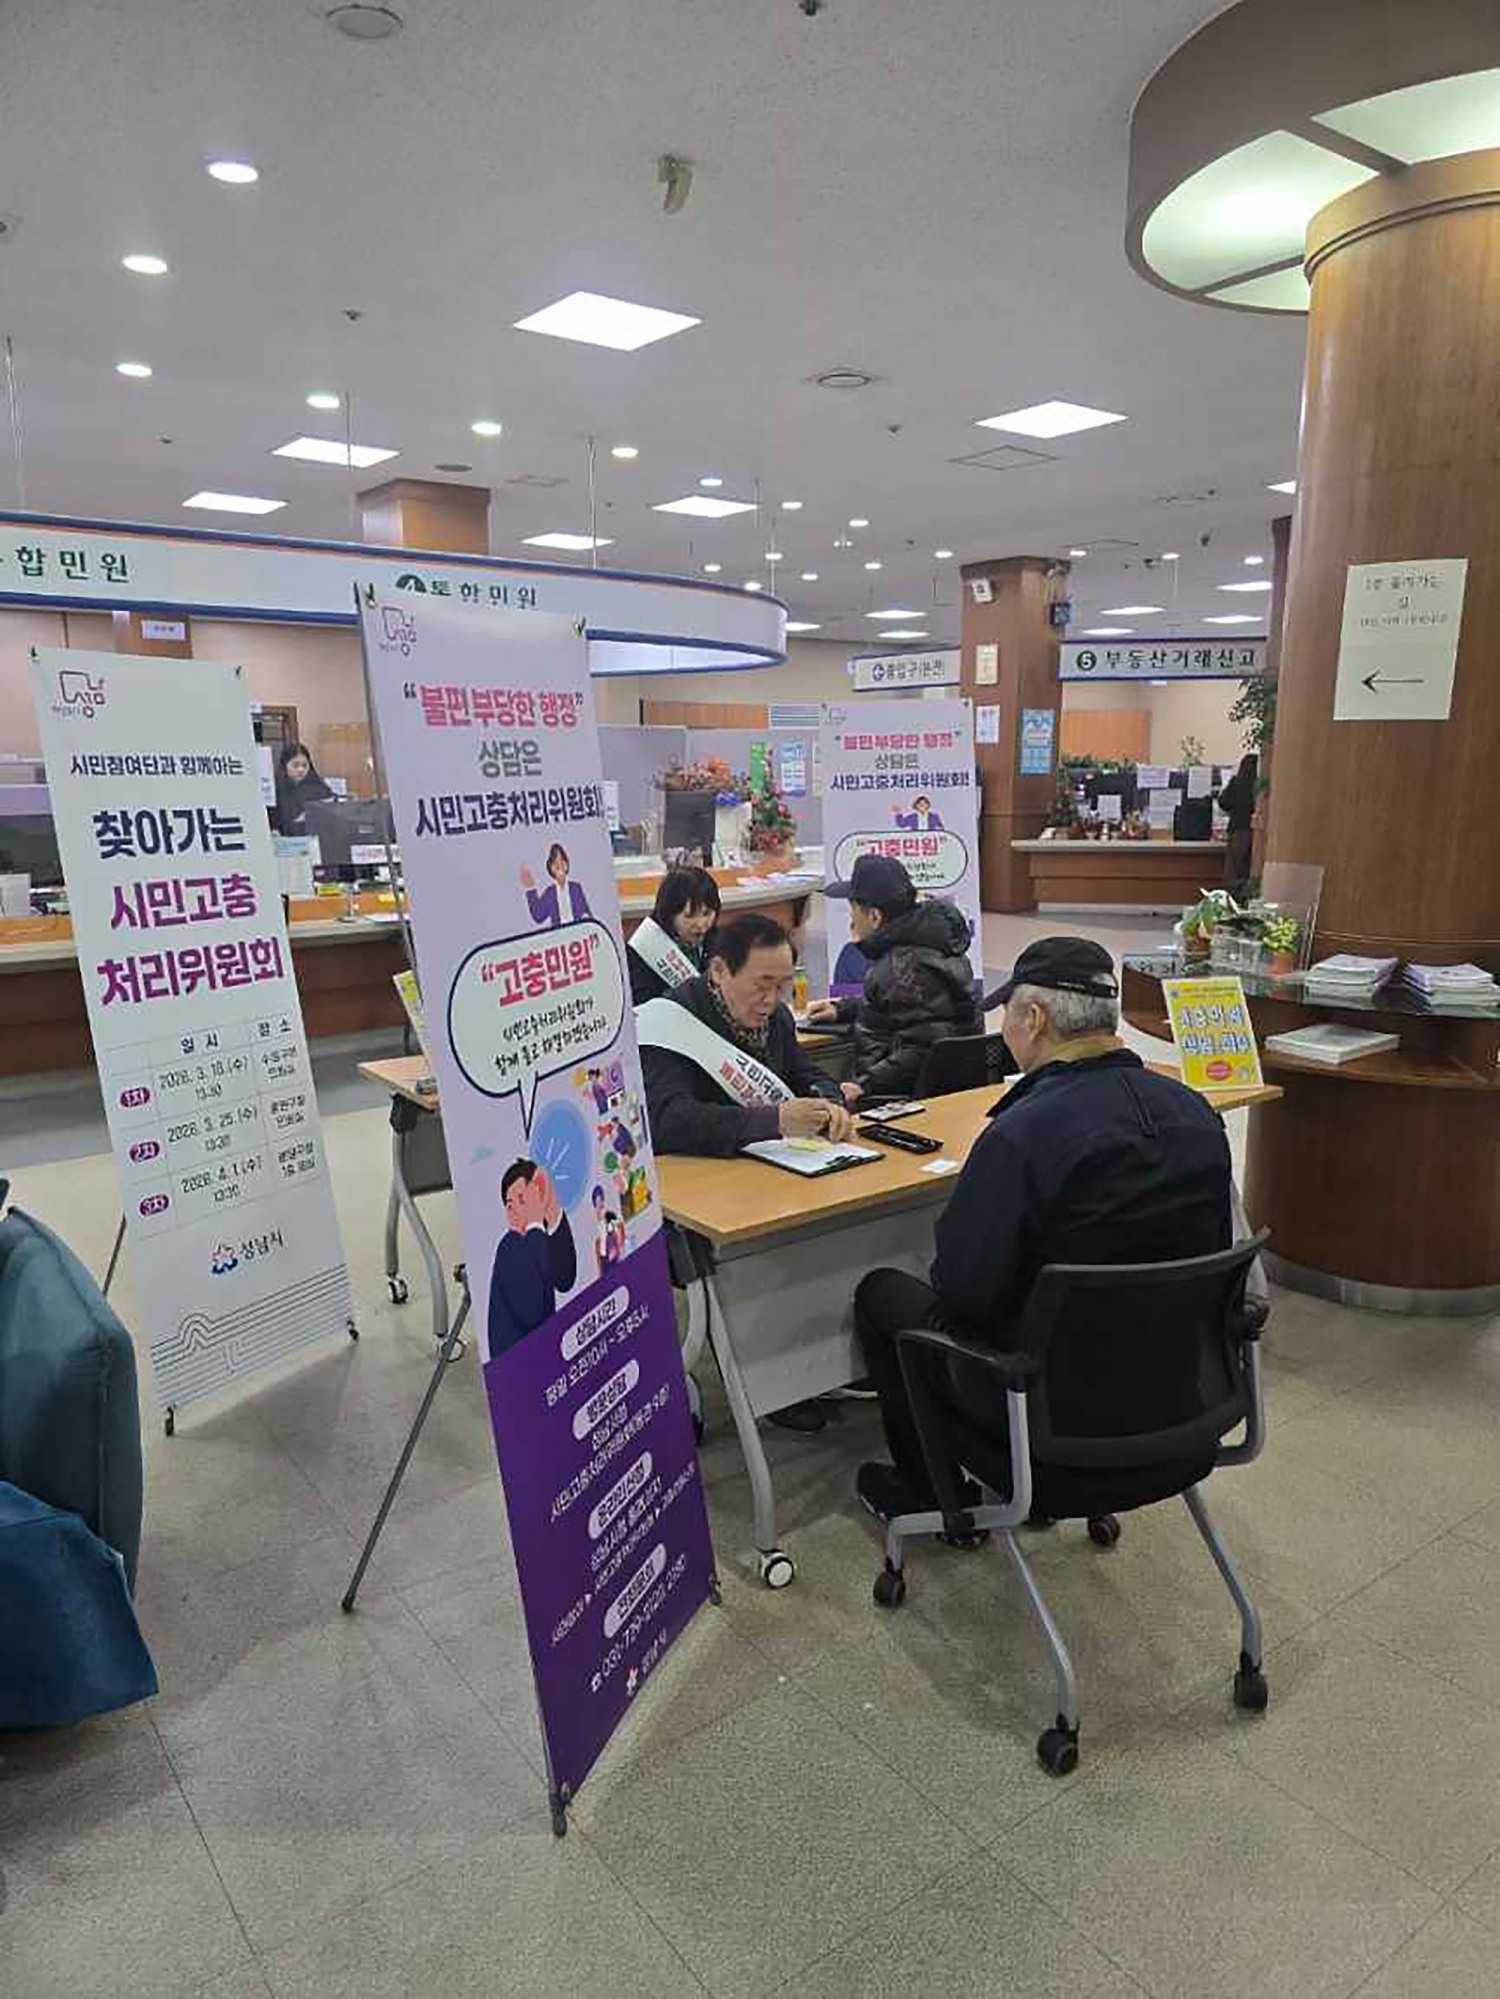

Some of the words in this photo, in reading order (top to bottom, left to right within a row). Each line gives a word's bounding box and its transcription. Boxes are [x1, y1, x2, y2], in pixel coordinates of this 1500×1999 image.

[1106, 649, 1255, 669] 부동산거래신고
[71, 754, 177, 775] 시민참여단과
[181, 756, 243, 776] 함께하는
[479, 740, 542, 778] 상담은
[875, 753, 918, 770] 상담은
[92, 808, 246, 859] 찾아가는
[111, 873, 256, 930] 시민고충
[97, 936, 284, 1005] 처리위원회
[481, 934, 599, 1007] “고충민원”
[239, 1230, 285, 1260] 성남시
[576, 1298, 616, 1346] 상담시간
